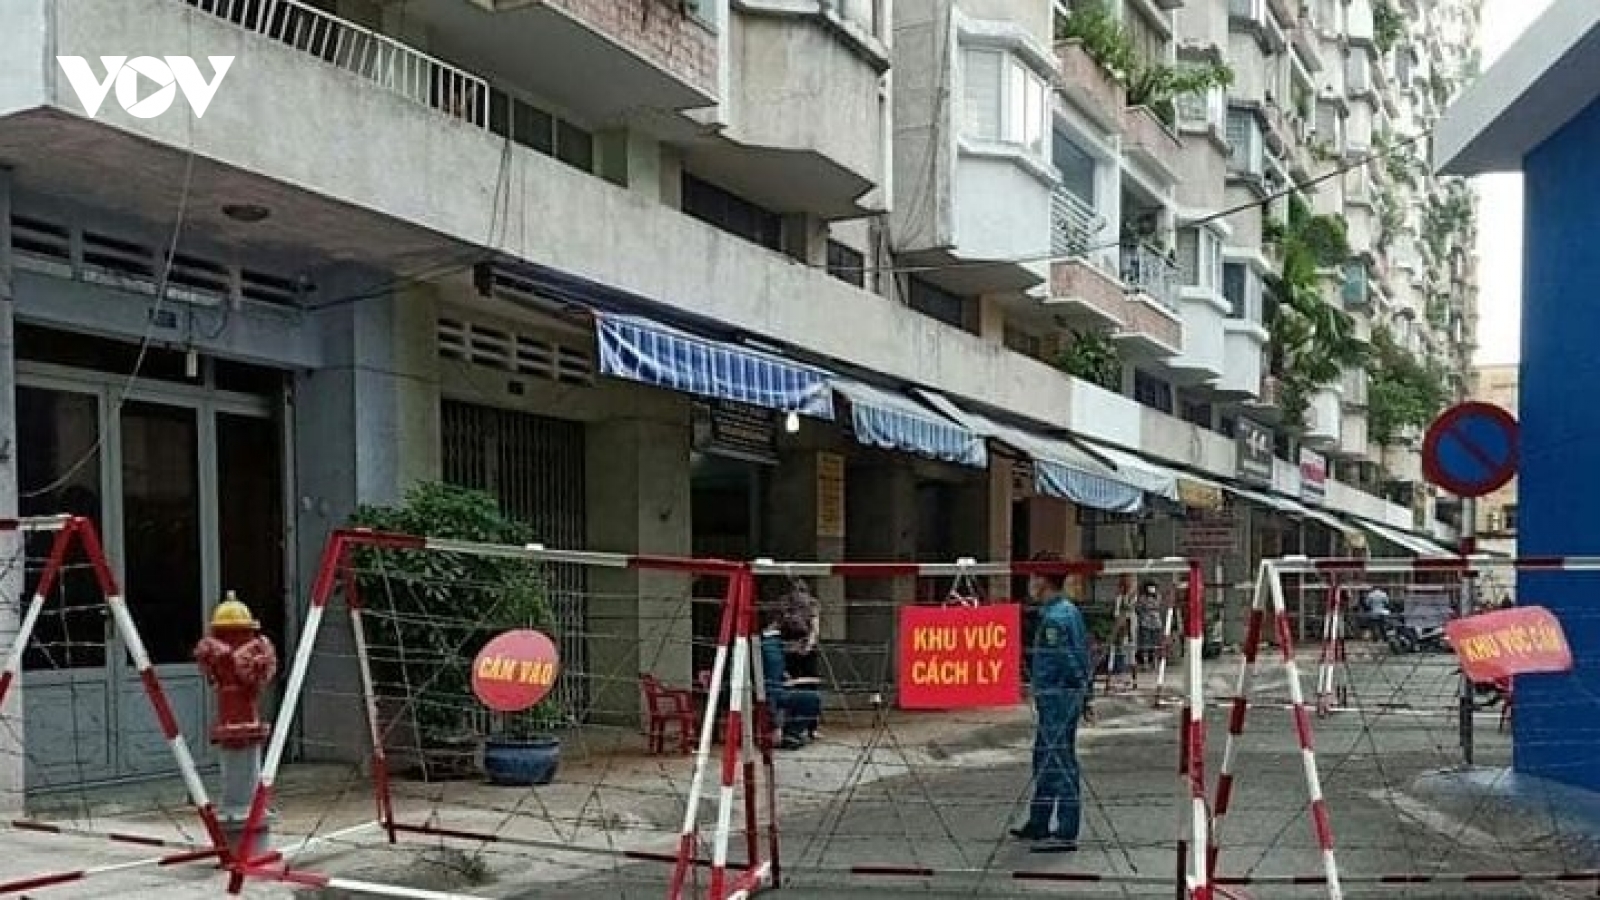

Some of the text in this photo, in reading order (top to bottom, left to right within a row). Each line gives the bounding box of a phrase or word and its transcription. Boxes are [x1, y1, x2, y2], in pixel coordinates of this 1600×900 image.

[914, 621, 1007, 655] KHU VỰC
[912, 655, 1003, 685] CÁCH LY
